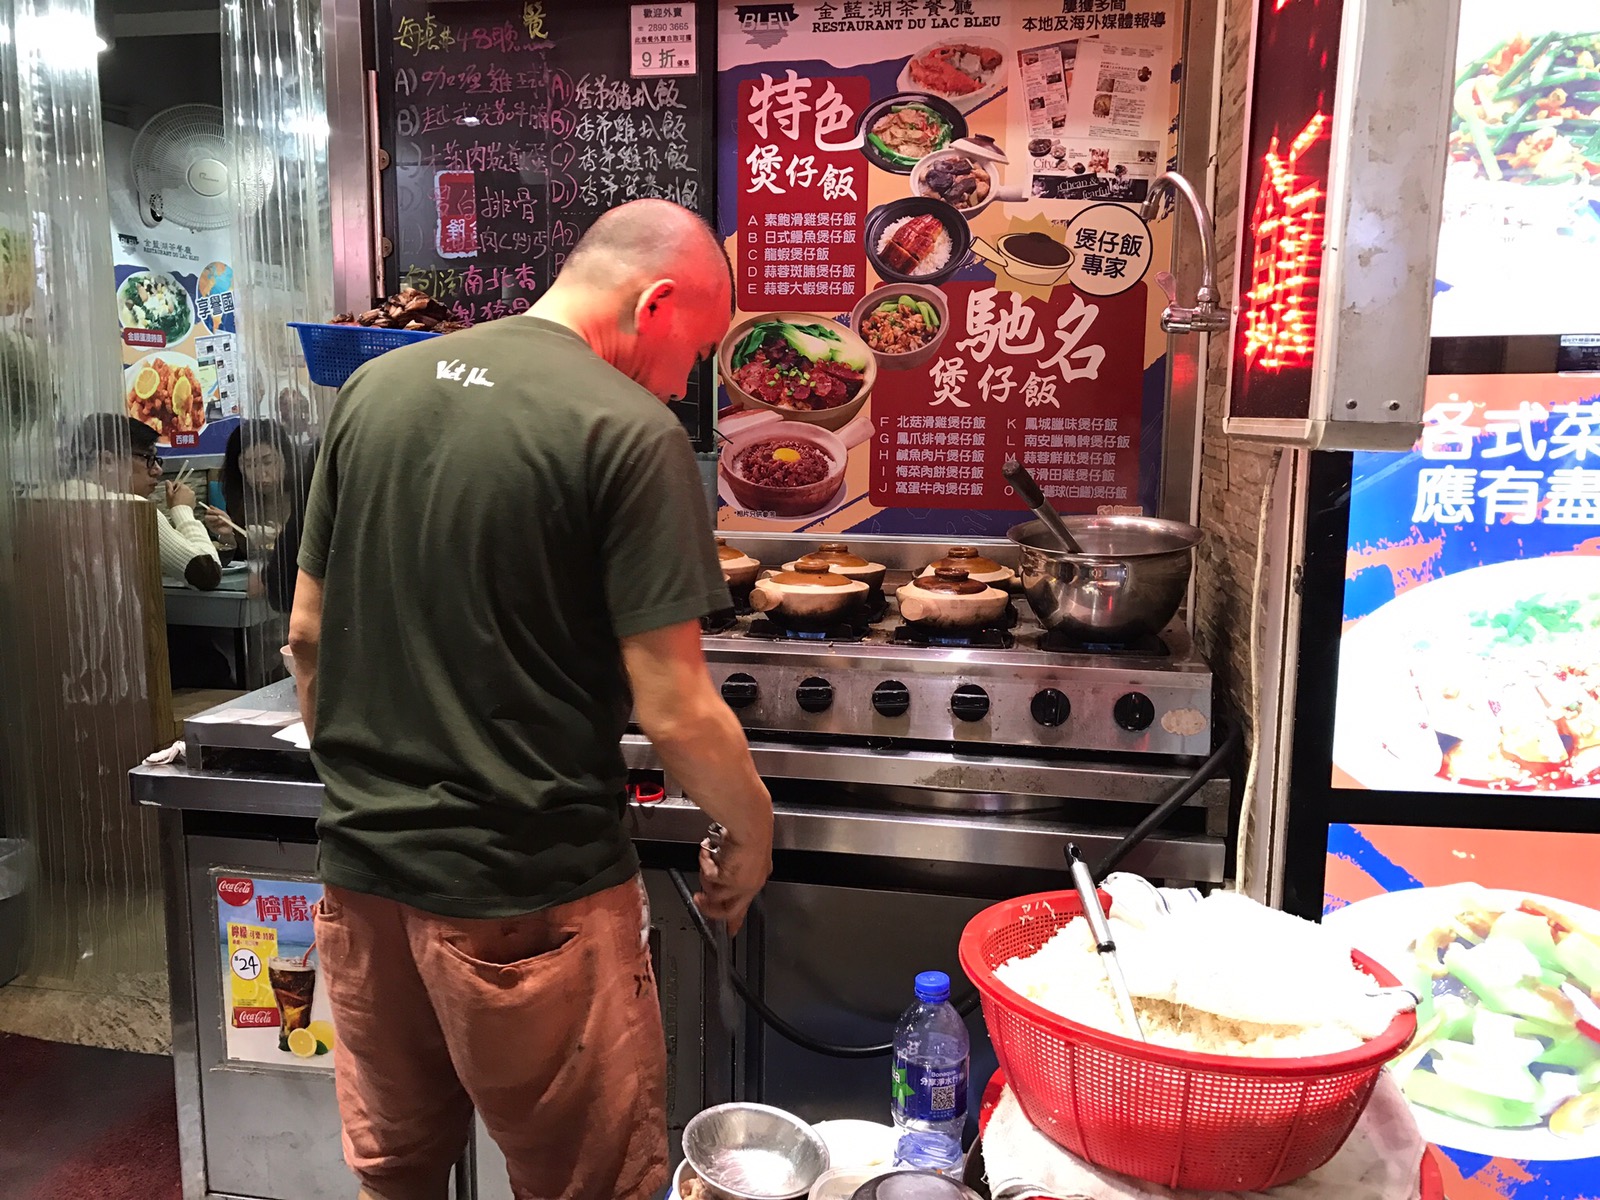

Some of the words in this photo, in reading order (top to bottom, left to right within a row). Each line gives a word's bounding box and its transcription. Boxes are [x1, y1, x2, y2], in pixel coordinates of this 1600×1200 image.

[813, 0, 976, 21] 金藍湖茶餐廳
[648, 23, 668, 32] 2890
[669, 22, 690, 32] 3665
[741, 12, 791, 31] BLEU
[812, 19, 903, 33] RESTAURANT
[907, 19, 927, 29] DU
[931, 18, 959, 29] LAC
[963, 16, 1002, 28] BLEU
[1021, 12, 1167, 33] 本地及海外媒體報導
[641, 51, 653, 68] 9
[658, 48, 676, 69] 折
[746, 69, 866, 152] 特色
[746, 143, 858, 202] 煲仔飯
[748, 215, 758, 226] A
[748, 232, 758, 244] B
[765, 230, 856, 244] 日式鰻魚煲仔飯
[1074, 227, 1144, 259] 煲仔飯
[748, 249, 758, 261] C
[764, 247, 829, 262] 龍蝦煲仔飯
[748, 267, 758, 278] D
[1081, 254, 1128, 280] 專家
[748, 283, 758, 295] E
[956, 287, 1106, 383] 馳名
[928, 357, 1061, 409] 煲仔飯
[880, 417, 890, 427] F
[896, 415, 986, 430] 北菇滑雞煲仔飯
[1006, 418, 1017, 429] K
[879, 433, 890, 445] G
[896, 432, 986, 446] 鳳爪排骨煲仔飯
[1006, 436, 1016, 446] L
[879, 450, 889, 461] H
[878, 482, 889, 494] J
[1004, 485, 1014, 496] O
[218, 880, 251, 894] Coca-Cola
[256, 895, 309, 922] 檸檬
[239, 1010, 271, 1024] Coca-Cola
[931, 1071, 956, 1080] Bonaqua
